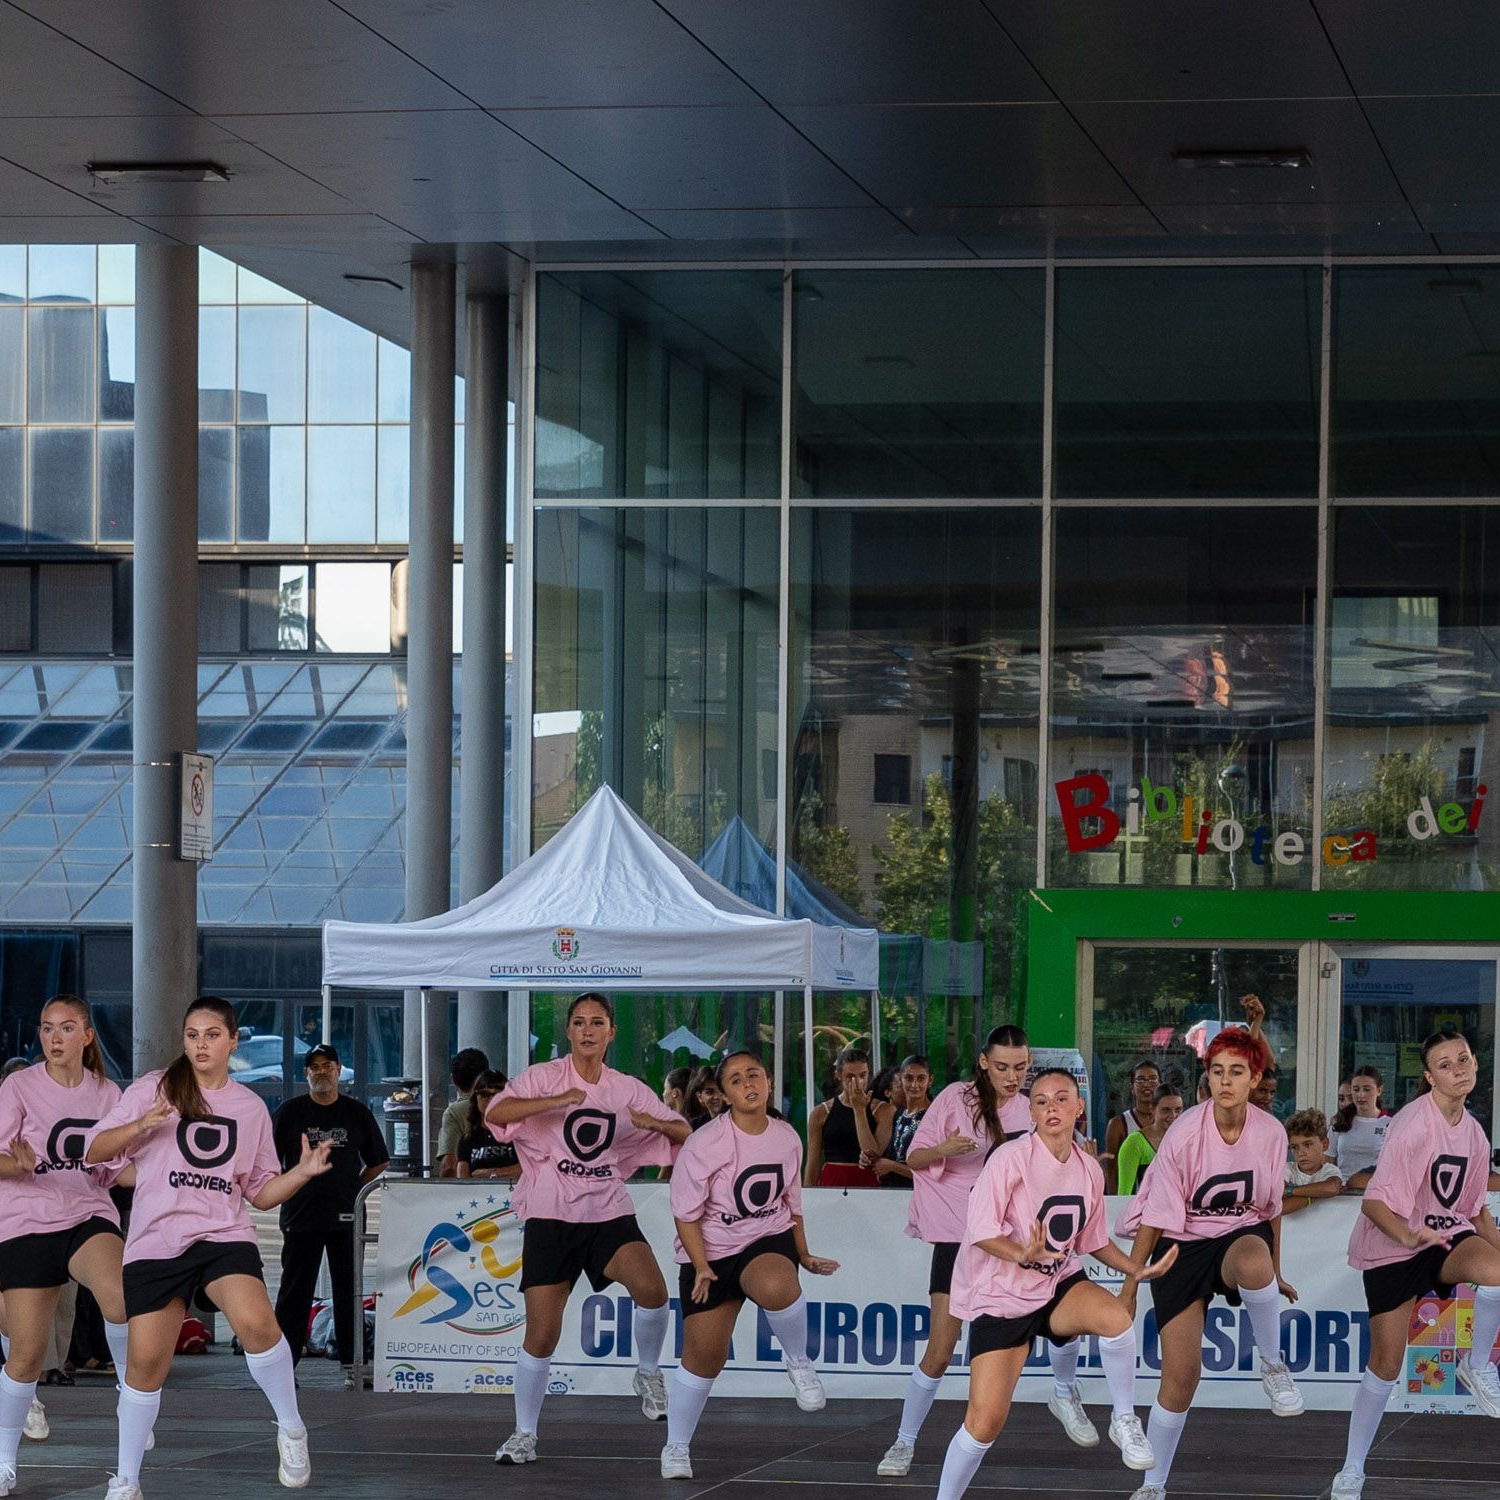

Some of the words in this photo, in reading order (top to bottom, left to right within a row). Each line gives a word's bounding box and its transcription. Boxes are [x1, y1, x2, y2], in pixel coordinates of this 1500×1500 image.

[1054, 772, 1378, 868] Biblioteca
[1407, 784, 1488, 841] dei
[536, 965, 566, 974] SESTO
[569, 965, 588, 974] SAN
[591, 965, 642, 974] GIOVANNI
[387, 1341, 446, 1355] EUROPEAN
[450, 1344, 473, 1355] CITY
[476, 1345, 491, 1356] OF
[394, 1370, 434, 1383] aces
[474, 1373, 514, 1386] aces
